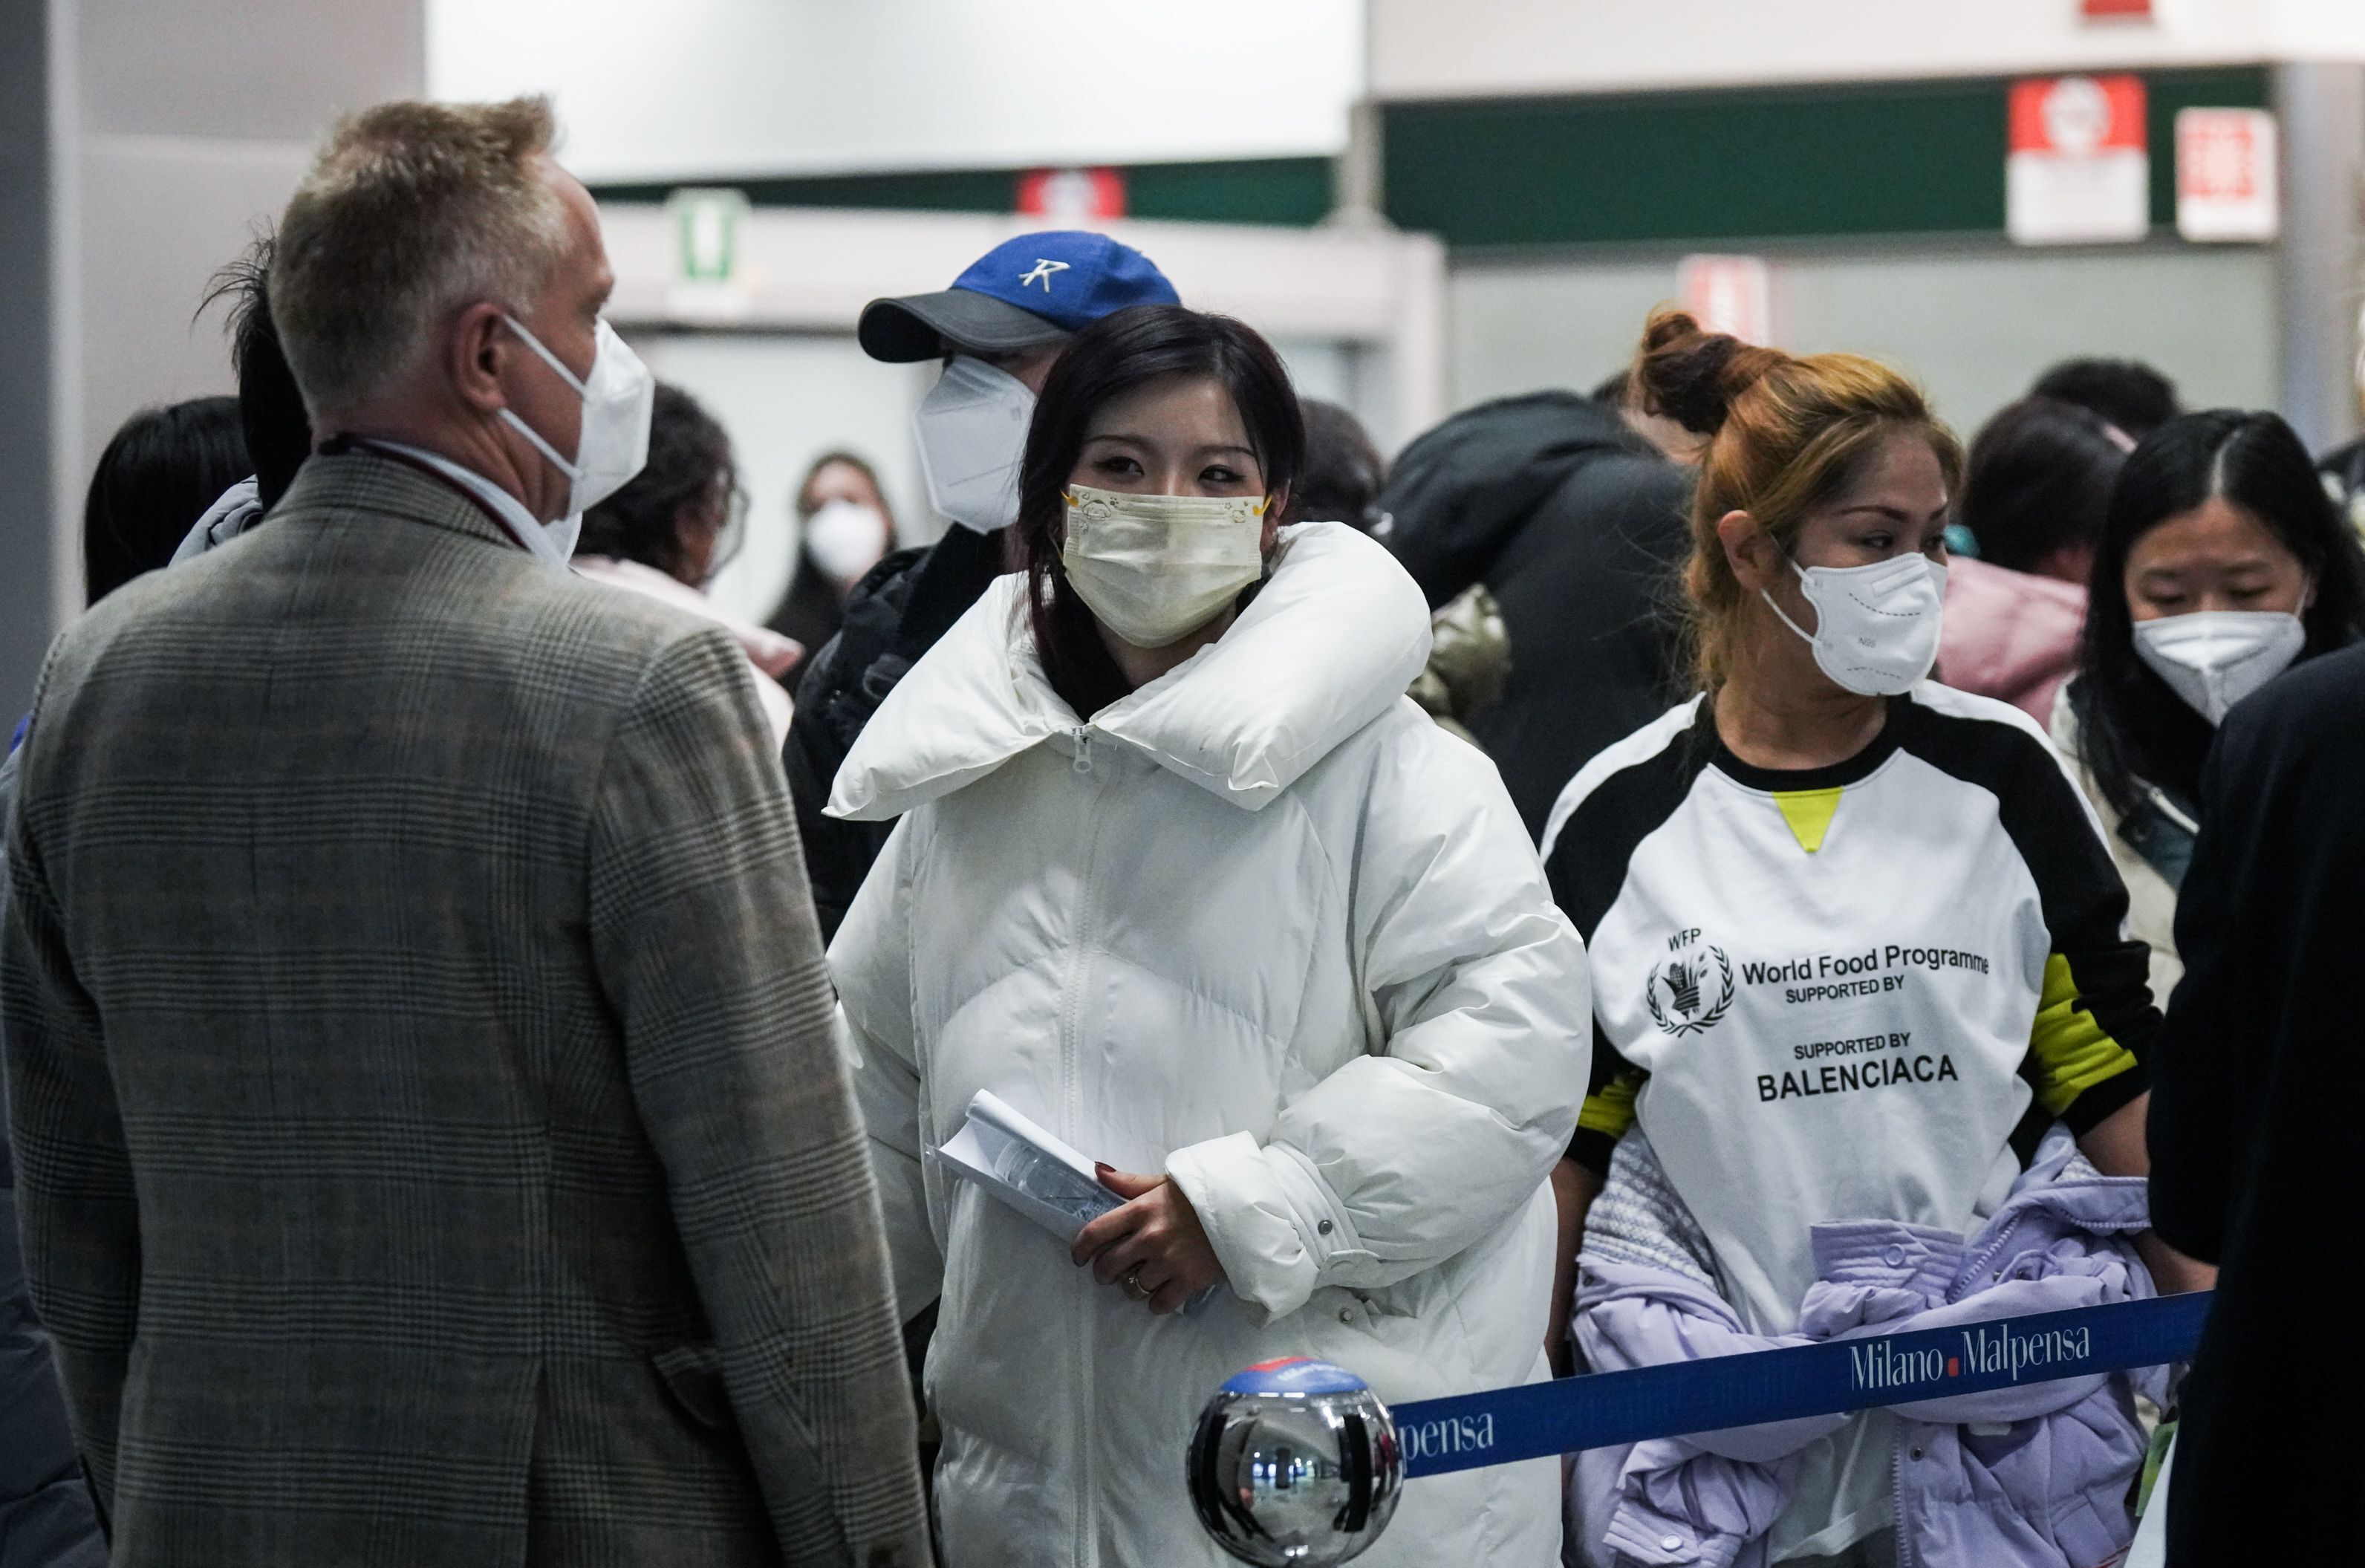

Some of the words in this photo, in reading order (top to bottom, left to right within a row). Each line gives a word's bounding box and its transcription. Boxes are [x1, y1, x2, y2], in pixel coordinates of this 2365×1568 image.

[1668, 928, 1701, 951] WFP
[1742, 958, 1812, 985] World
[1819, 949, 1878, 977] Food
[1886, 945, 1990, 975] Programme
[1786, 979, 1879, 1003] SUPPORTED
[1884, 975, 1904, 991] BY
[1795, 1035, 1885, 1059] SUPPORTED
[1889, 1032, 1910, 1047] BY
[1849, 1340, 1943, 1390] Milano
[1961, 1324, 2090, 1381] Malpensa
